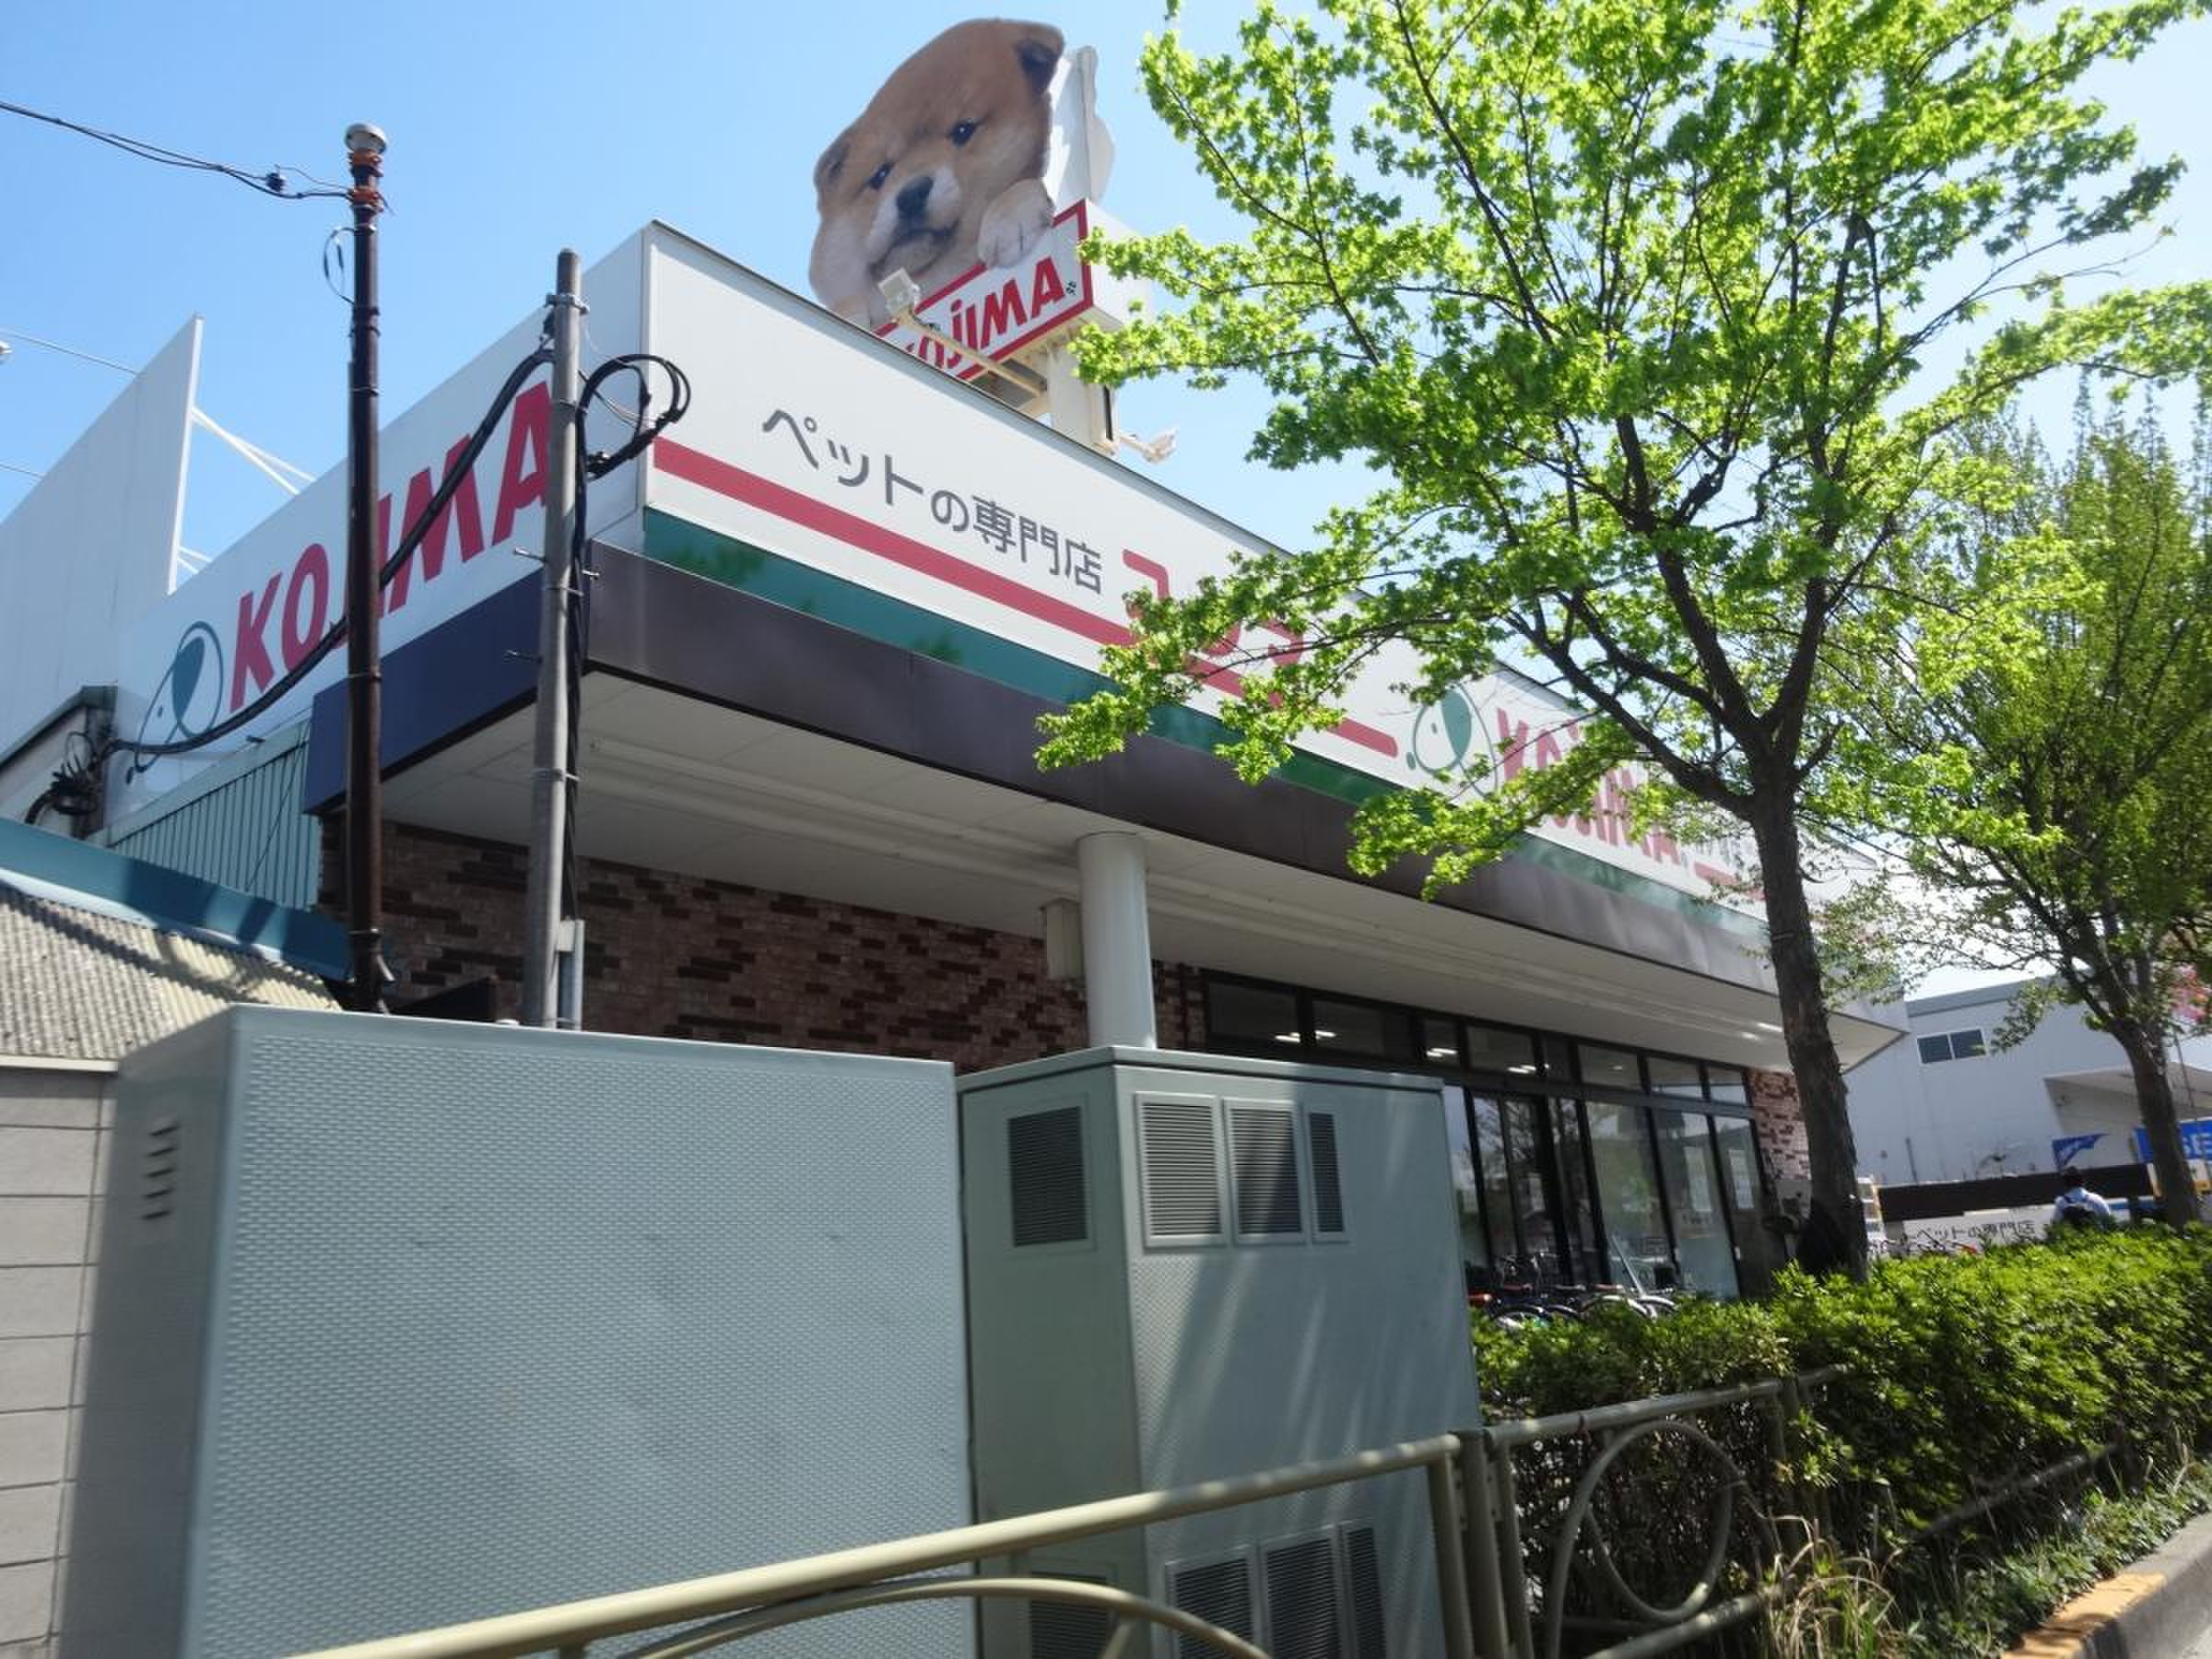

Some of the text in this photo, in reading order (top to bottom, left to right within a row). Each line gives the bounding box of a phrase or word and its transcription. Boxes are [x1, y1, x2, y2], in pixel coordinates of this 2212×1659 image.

[762, 408, 1102, 594] ペットの専門店
